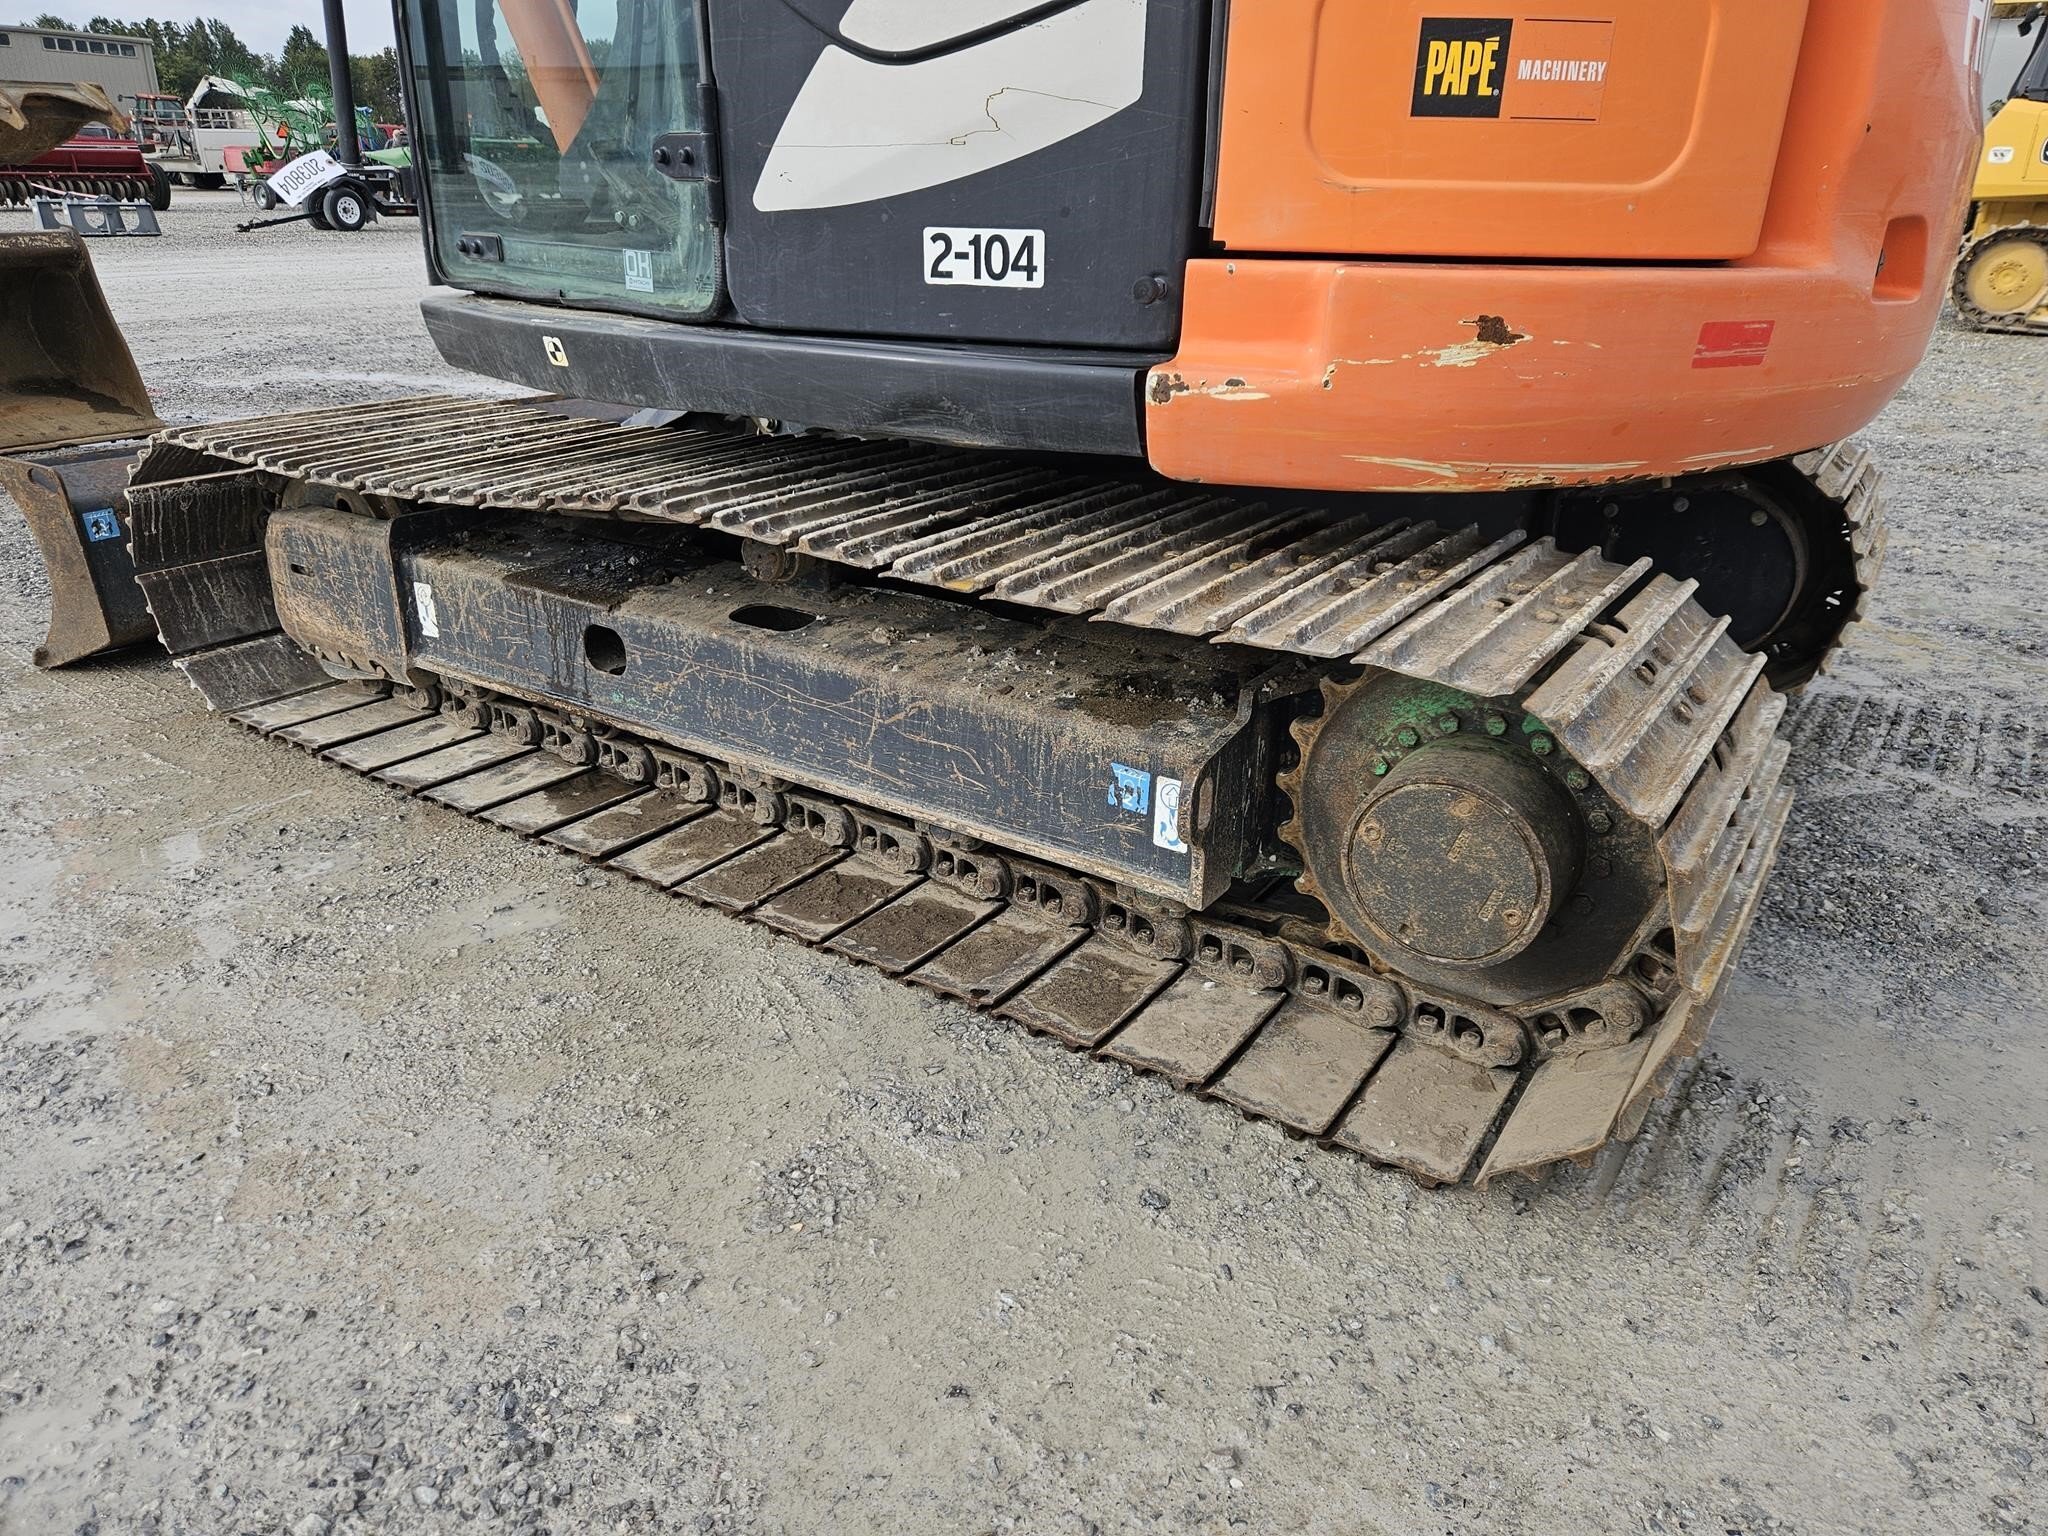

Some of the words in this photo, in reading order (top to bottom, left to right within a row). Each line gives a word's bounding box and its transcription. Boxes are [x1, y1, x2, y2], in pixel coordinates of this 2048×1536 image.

[1424, 36, 1500, 96] PAPÉ
[1517, 59, 1607, 82] MACHINERY
[277, 158, 326, 195] 203804
[930, 232, 1038, 282] 2-104
